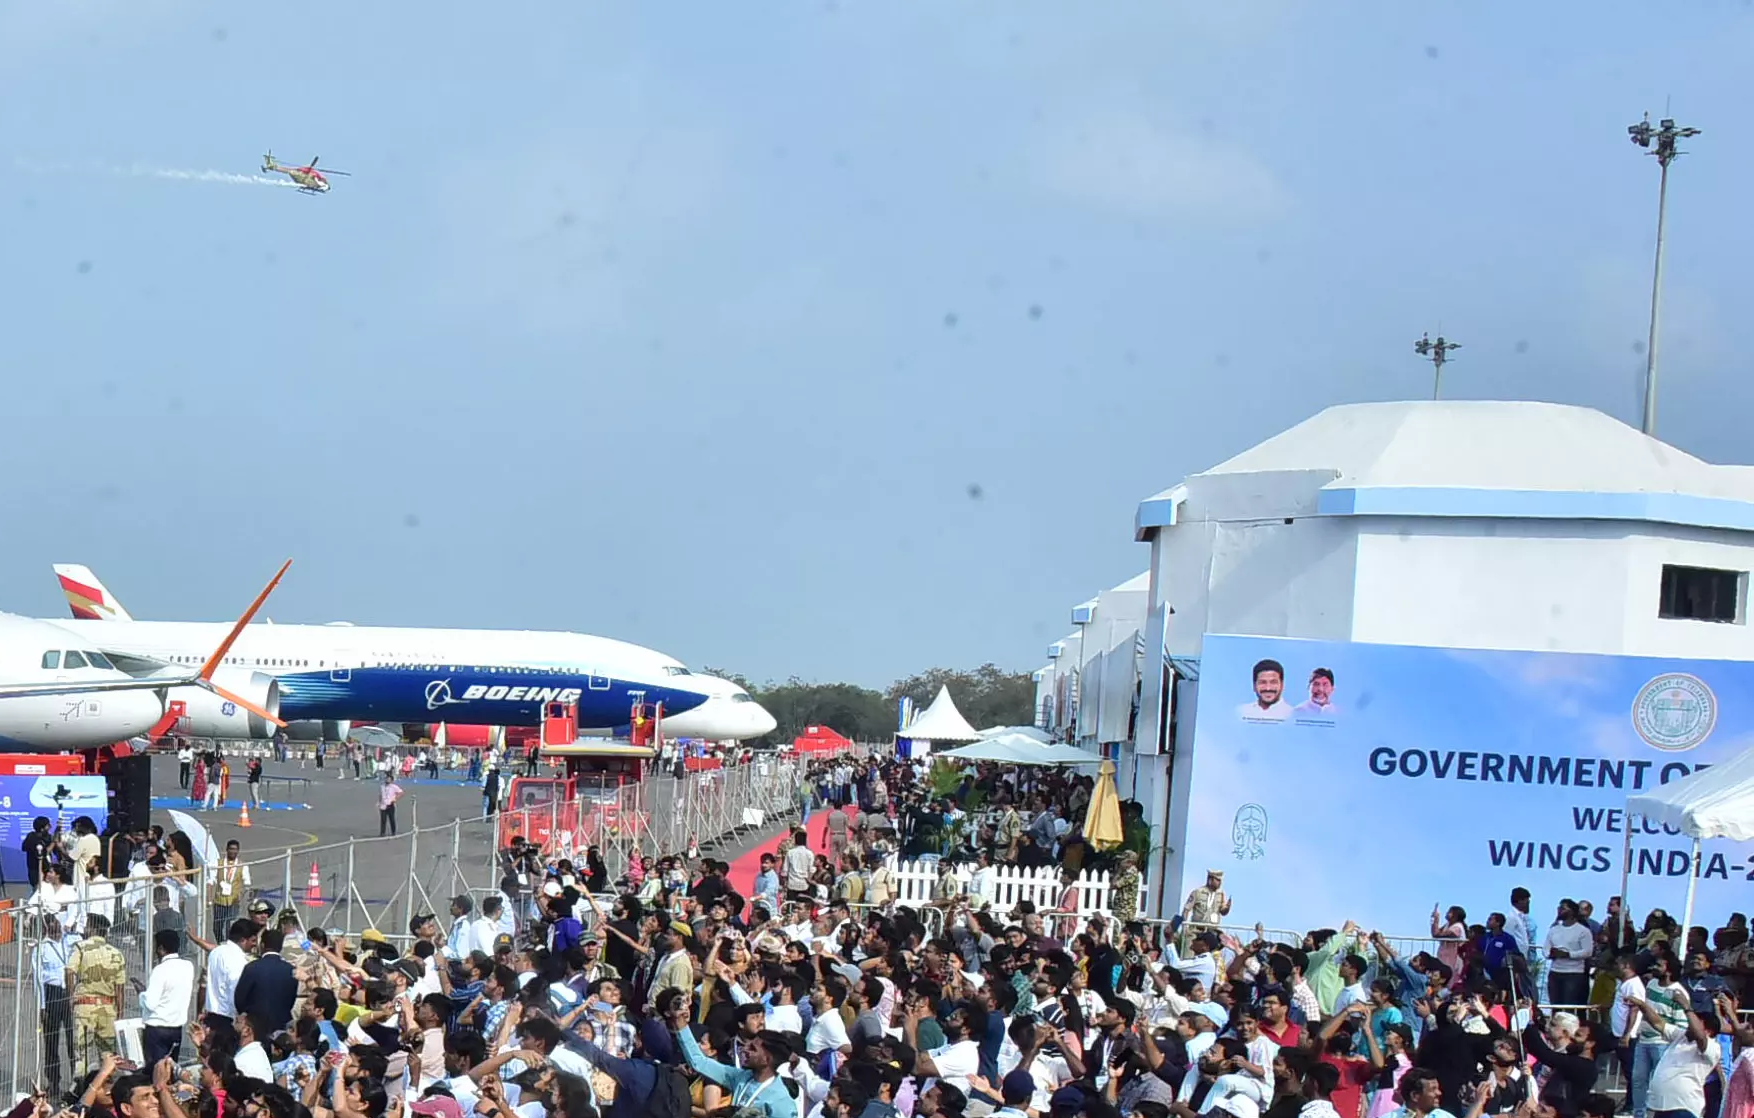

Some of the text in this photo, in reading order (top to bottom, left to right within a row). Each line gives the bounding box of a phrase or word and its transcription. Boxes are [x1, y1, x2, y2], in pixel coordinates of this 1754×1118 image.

[462, 685, 582, 701] BOEING
[1368, 747, 1652, 790] GOVERNMENT
[1488, 839, 1612, 872] WINGS
